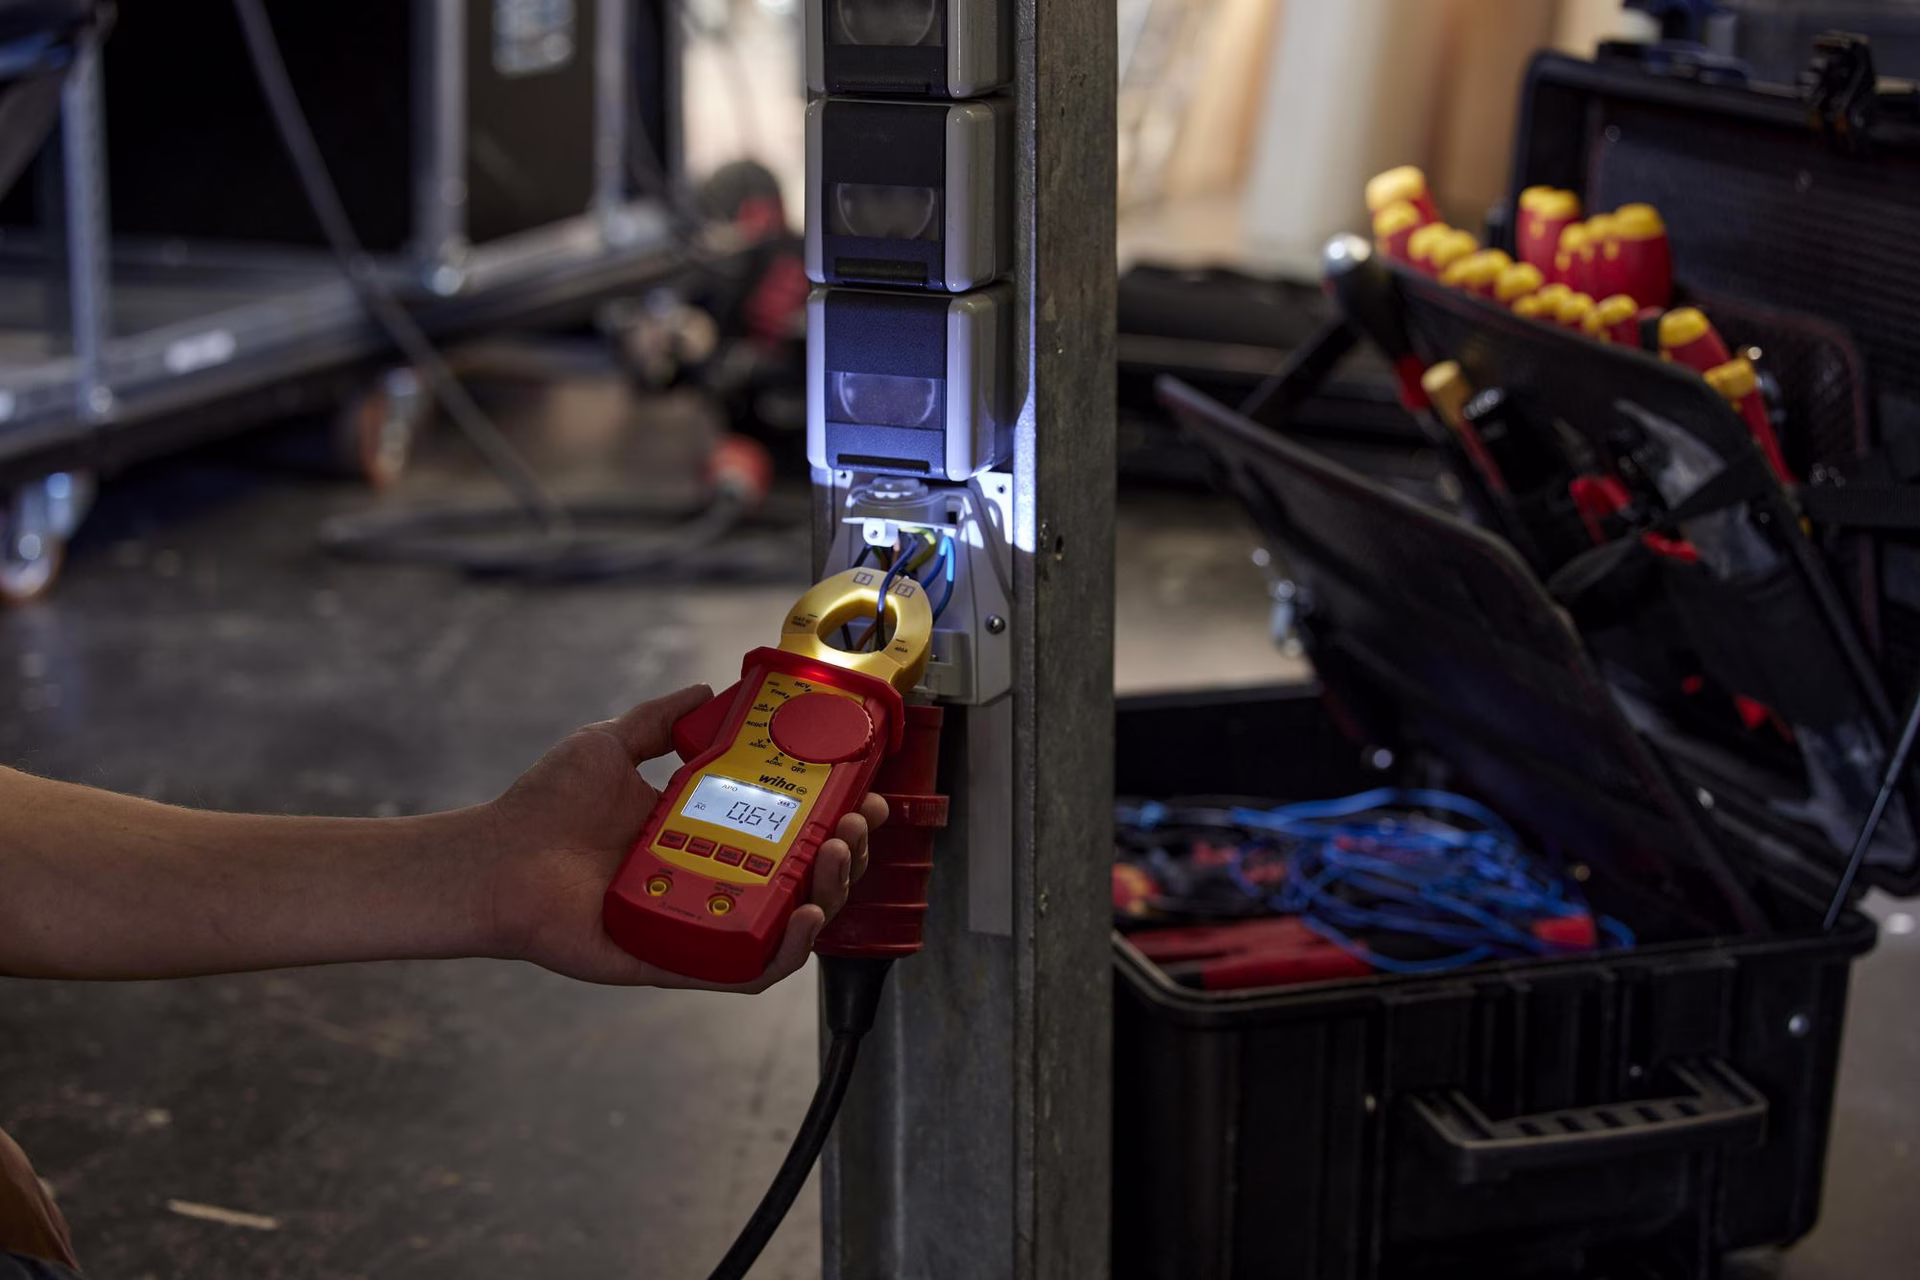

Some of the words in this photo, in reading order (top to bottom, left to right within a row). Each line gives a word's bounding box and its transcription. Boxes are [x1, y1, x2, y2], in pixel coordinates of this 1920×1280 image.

[794, 681, 811, 689] NCV
[791, 765, 807, 774] OFF
[758, 774, 798, 791] wiha
[694, 803, 707, 811] AC
[726, 801, 787, 831] 0.64
